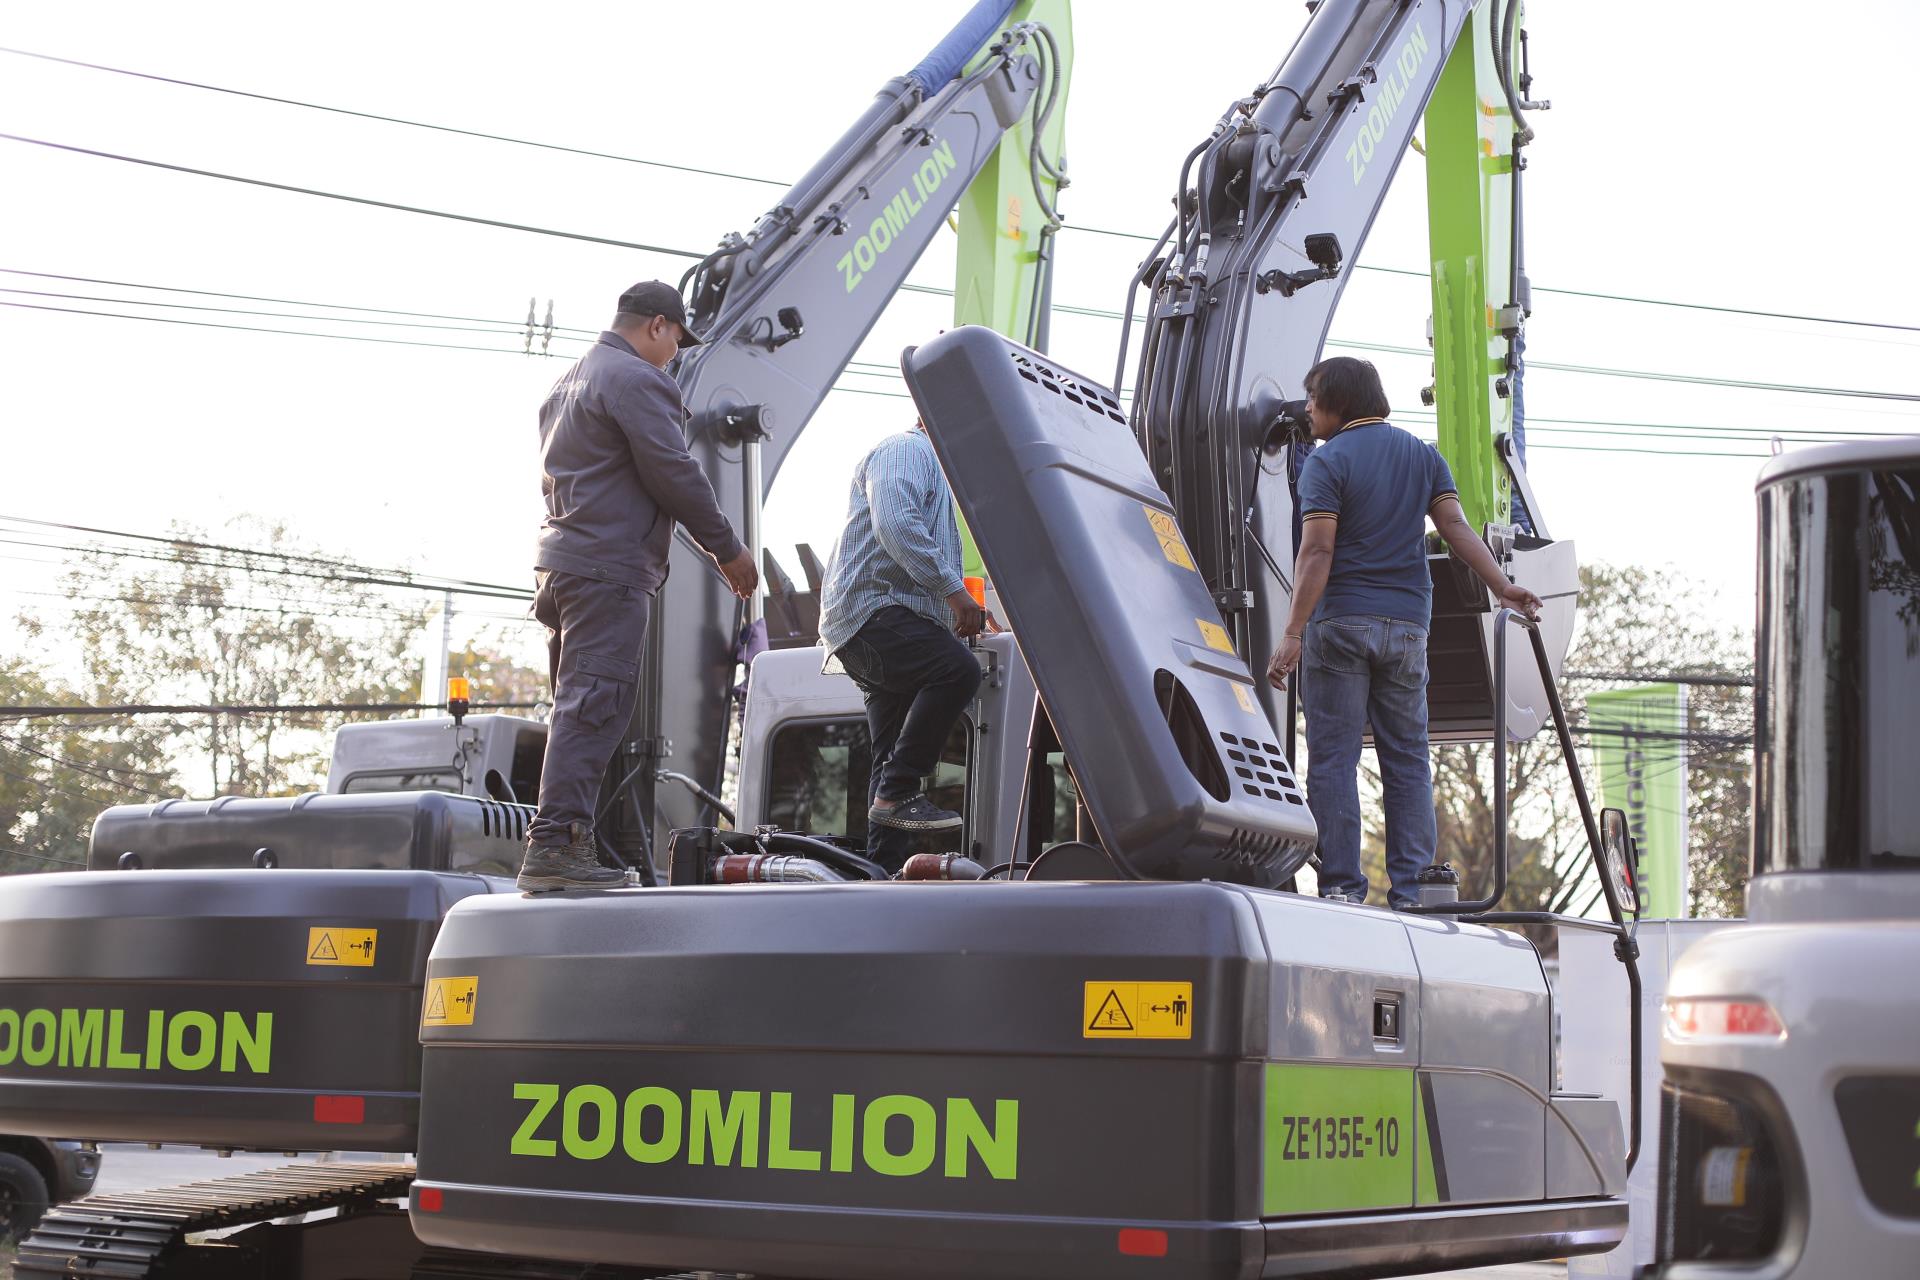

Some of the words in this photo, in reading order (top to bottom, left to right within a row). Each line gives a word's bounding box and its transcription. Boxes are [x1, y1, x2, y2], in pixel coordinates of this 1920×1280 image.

[1345, 22, 1429, 186] ZOOMLION
[836, 139, 957, 293] ZOOMLION
[0, 1008, 273, 1074] OOMLION
[510, 1083, 1019, 1180] ZOOMLION
[1282, 1116, 1399, 1160] ZE135E-10
